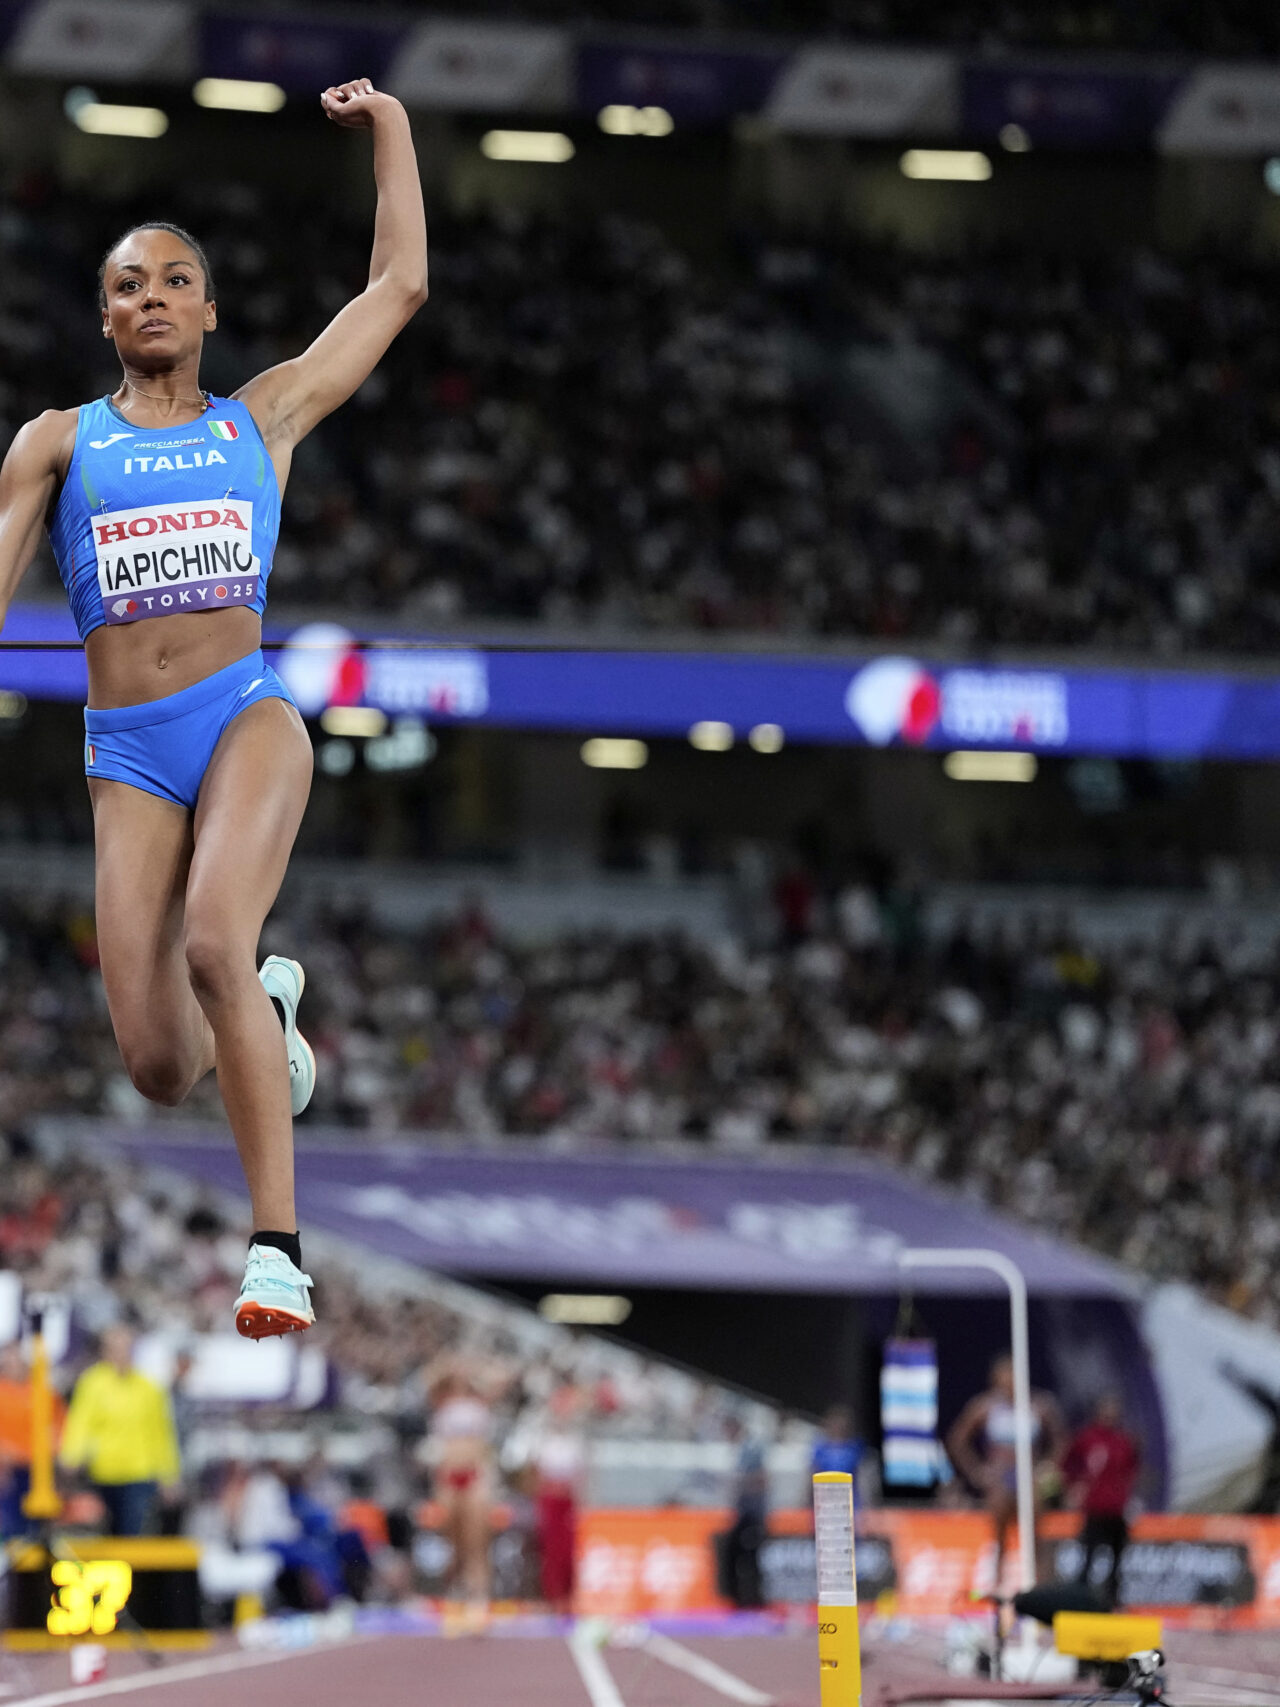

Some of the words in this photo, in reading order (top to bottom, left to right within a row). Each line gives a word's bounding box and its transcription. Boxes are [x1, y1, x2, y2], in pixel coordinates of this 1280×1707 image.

[133, 437, 206, 448] FRECCIAROSSA
[124, 449, 227, 474] ITALIA
[96, 509, 248, 545] HONDA
